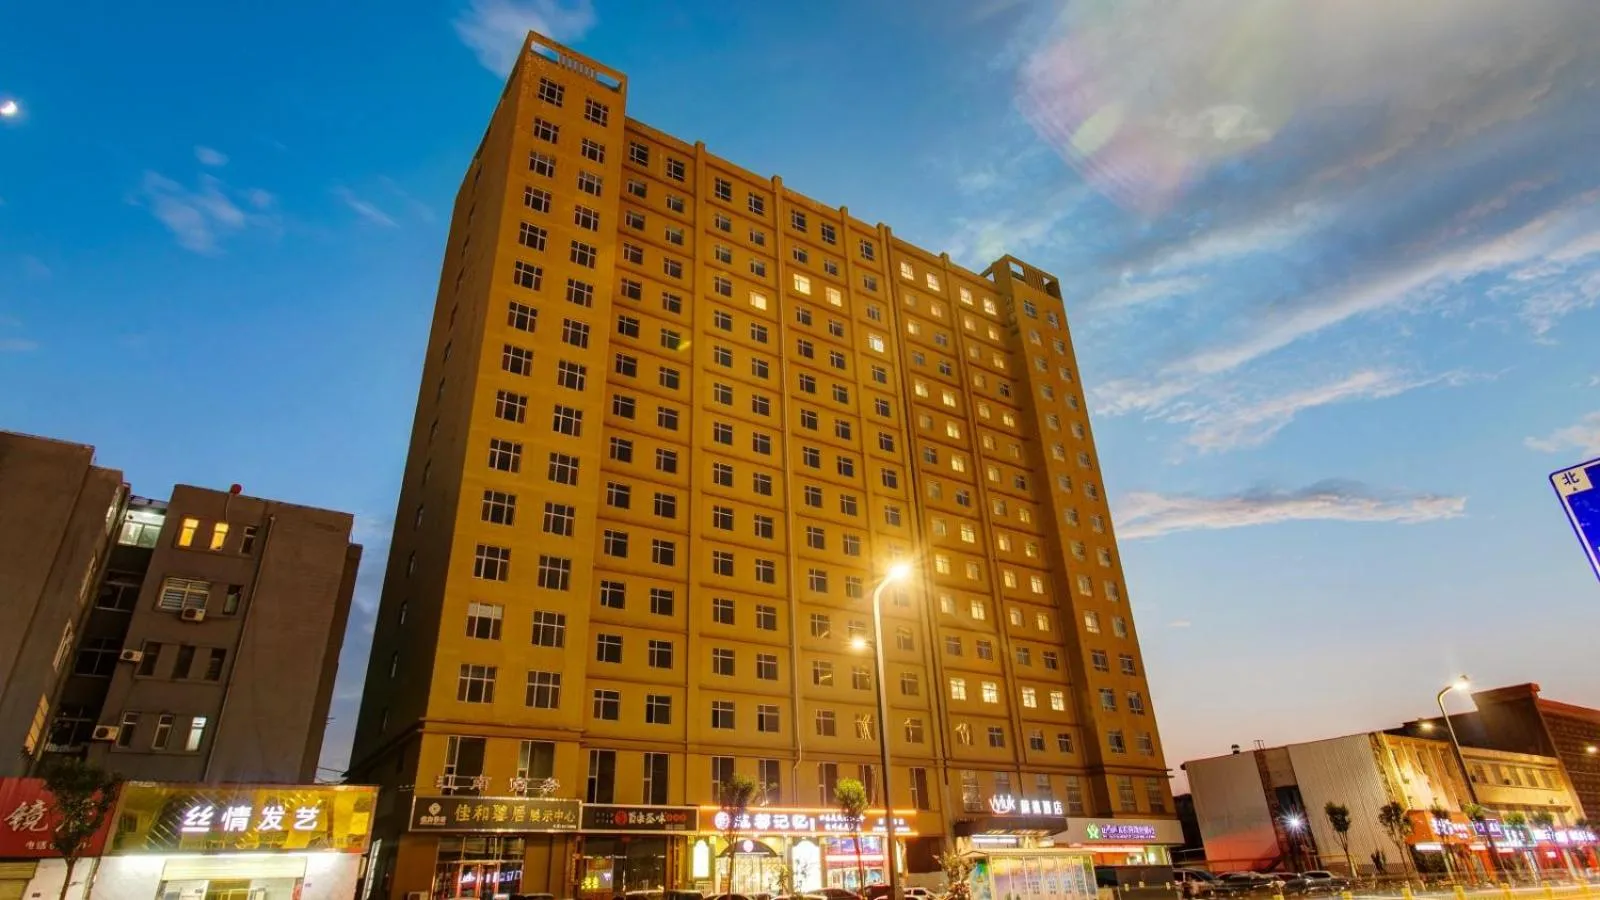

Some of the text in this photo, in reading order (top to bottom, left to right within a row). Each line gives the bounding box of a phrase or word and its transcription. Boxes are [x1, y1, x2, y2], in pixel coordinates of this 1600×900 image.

[1562, 471, 1580, 485] 北
[181, 805, 320, 833] 丝情发艺
